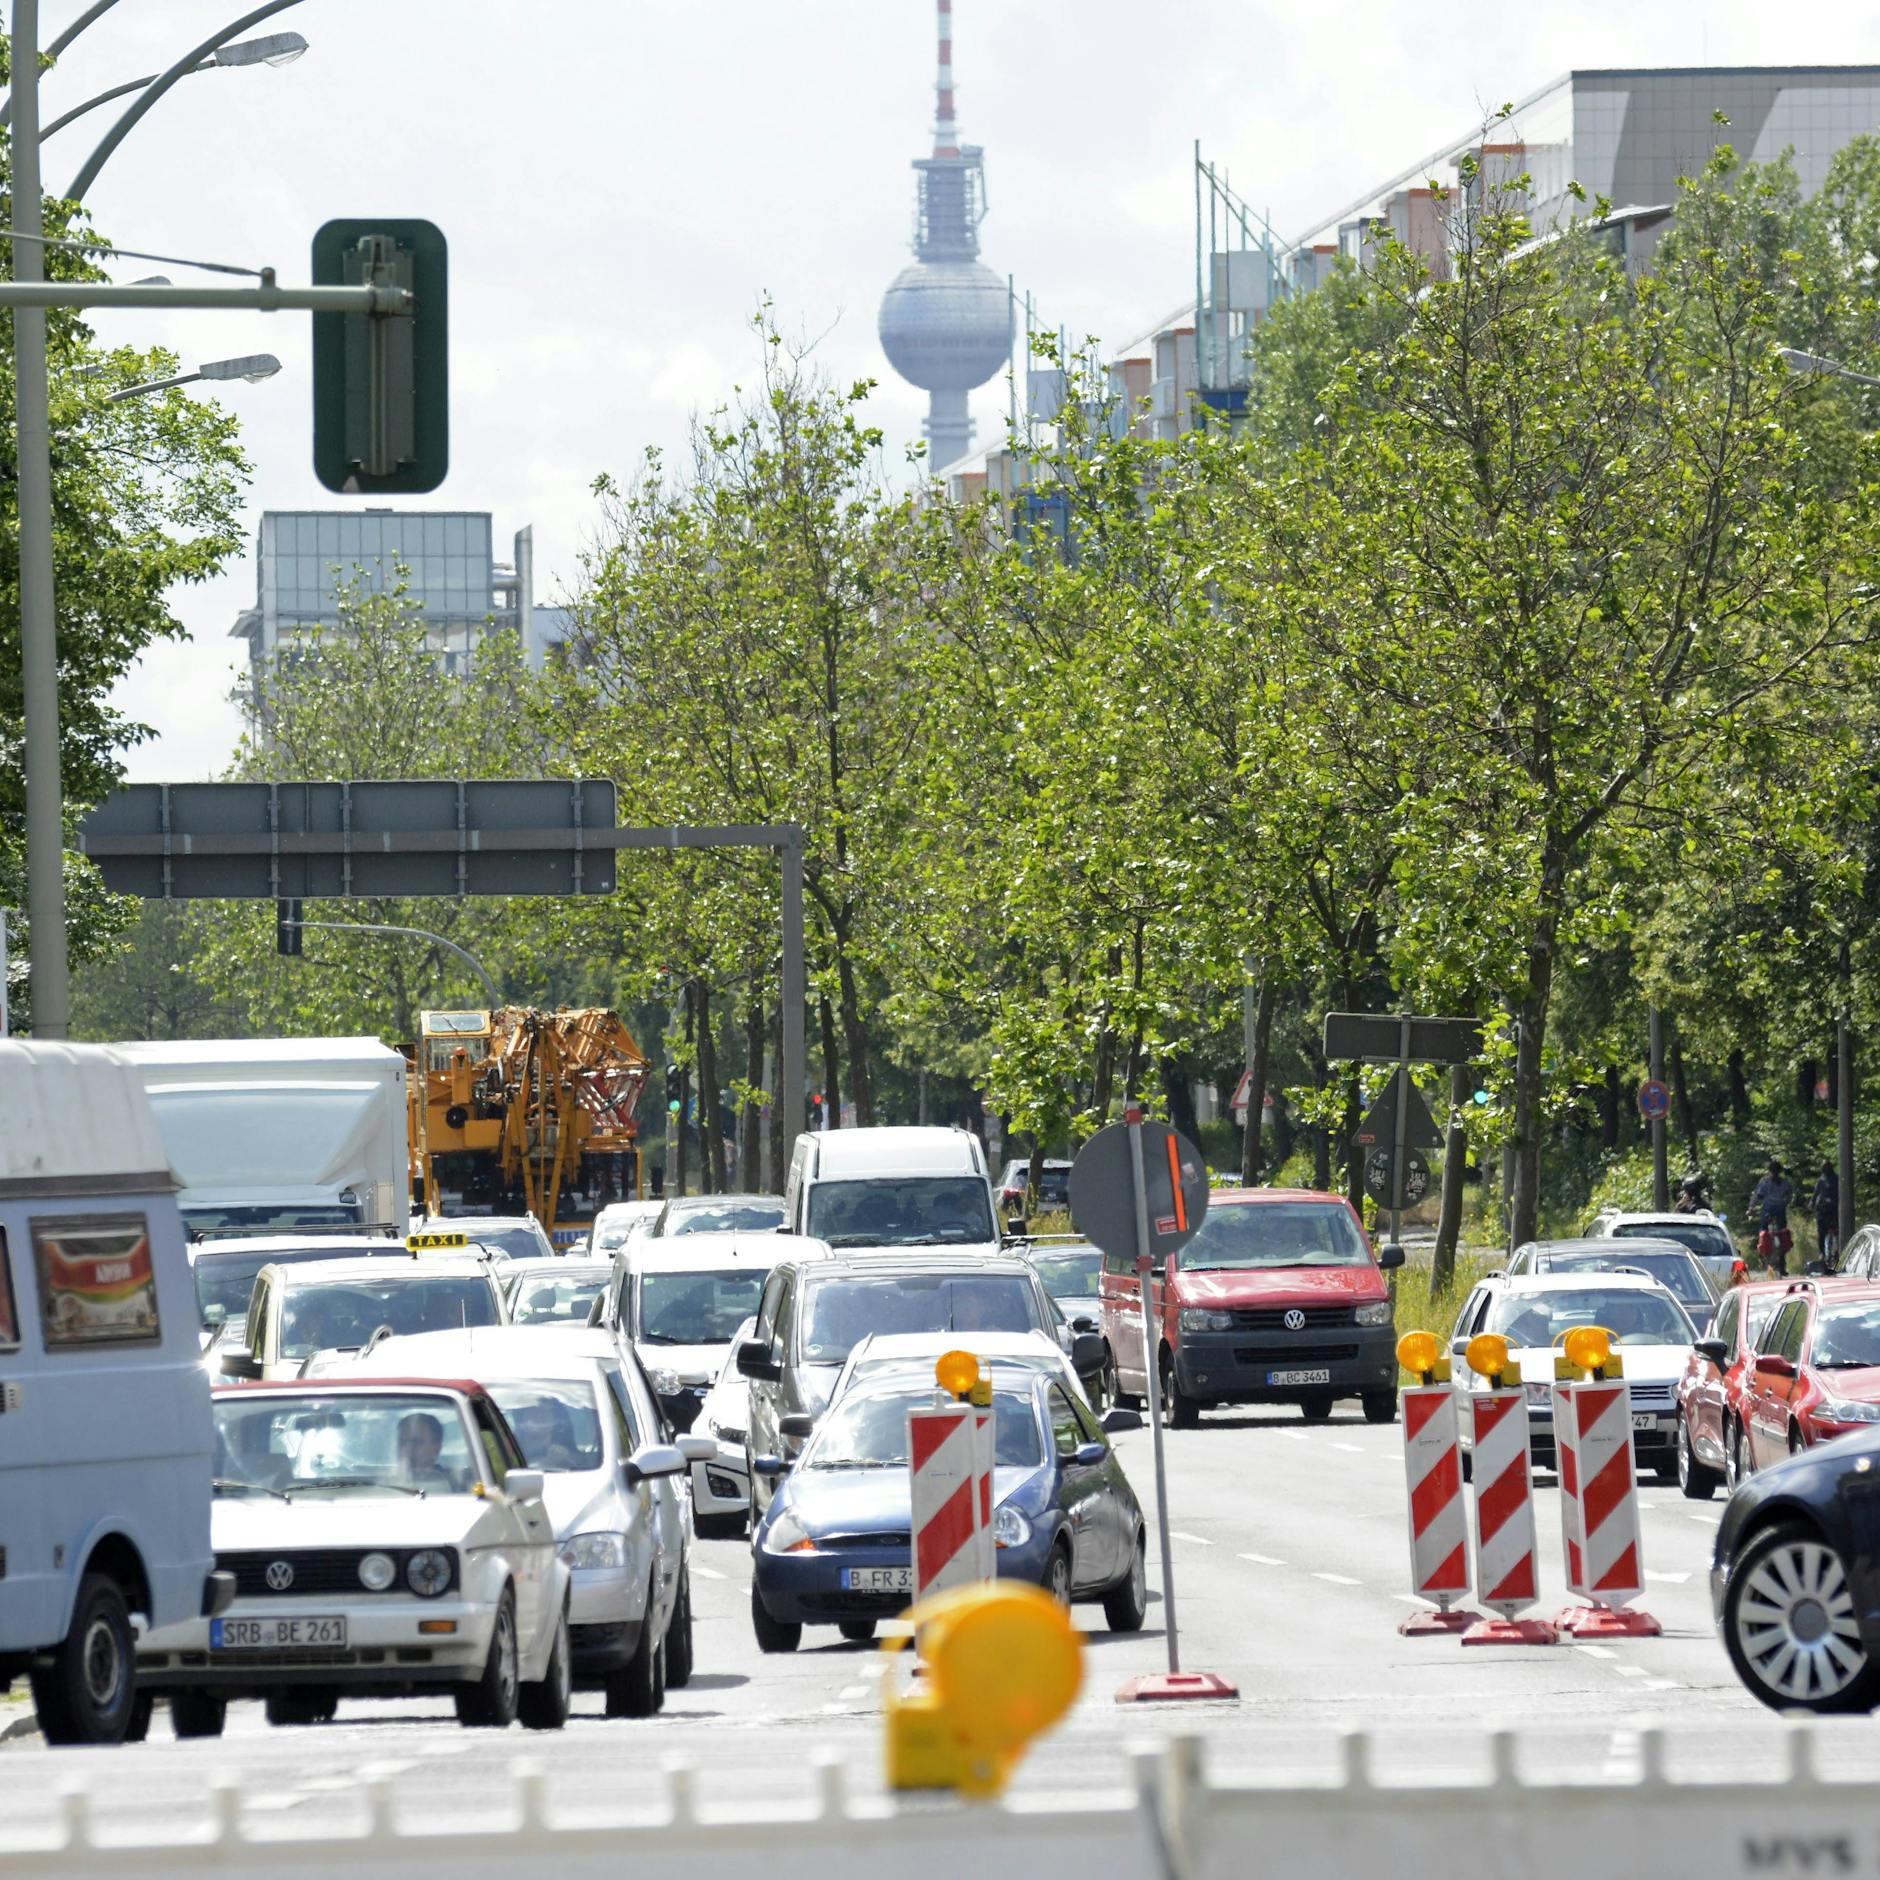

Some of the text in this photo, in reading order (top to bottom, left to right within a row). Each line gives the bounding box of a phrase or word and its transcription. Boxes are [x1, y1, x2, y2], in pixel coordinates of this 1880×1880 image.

[415, 1234, 457, 1246] TAXI
[1272, 1370, 1329, 1384] B BC 3461
[1632, 1416, 1649, 1428] 47
[850, 1570, 860, 1587] B
[871, 1570, 893, 1587] FR
[224, 1620, 342, 1645] SRB BE 261
